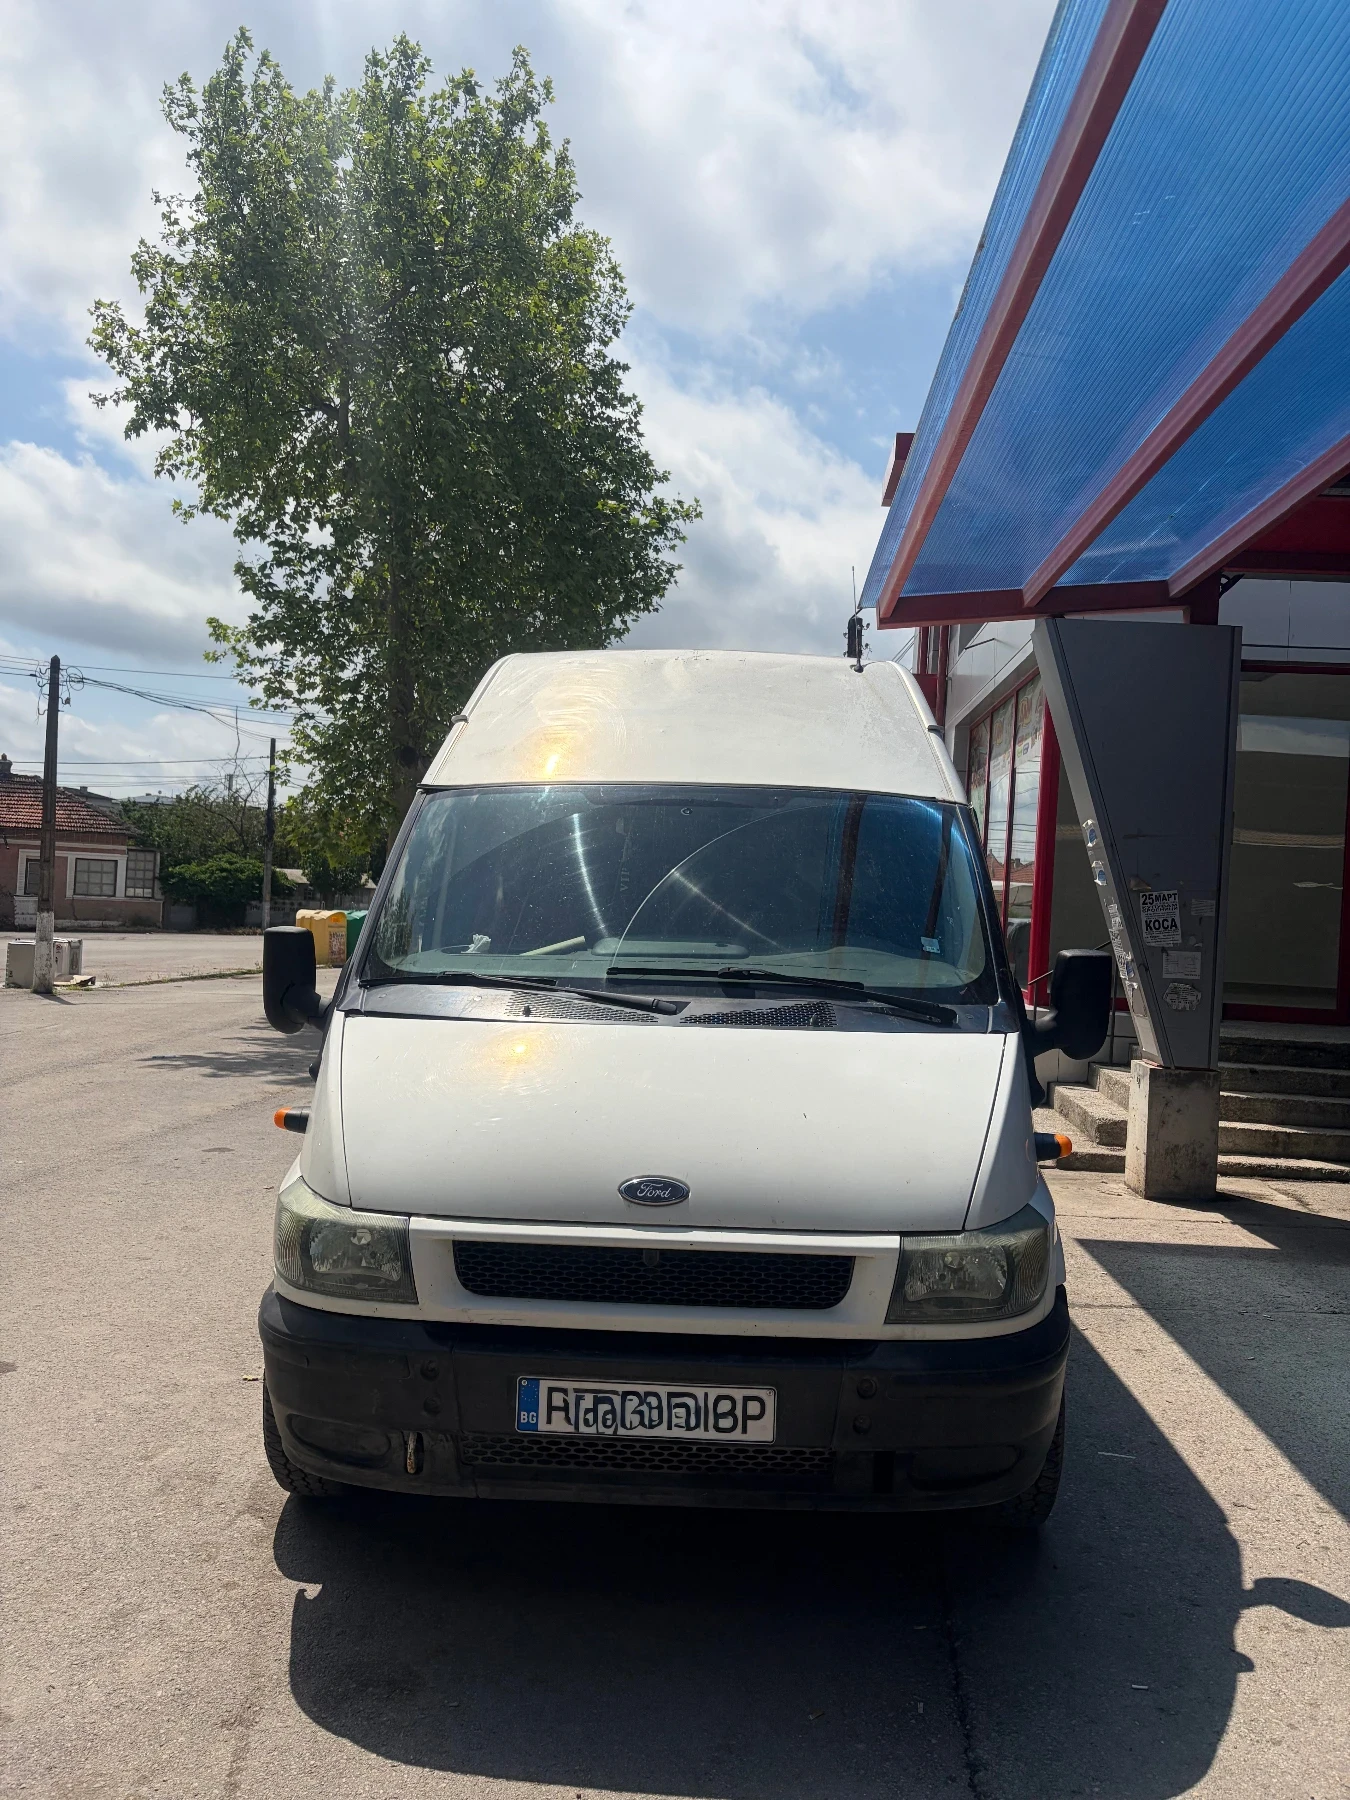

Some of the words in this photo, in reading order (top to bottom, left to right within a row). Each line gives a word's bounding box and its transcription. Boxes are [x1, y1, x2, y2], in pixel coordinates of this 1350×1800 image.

[1141, 893, 1155, 905] 25
[1154, 893, 1178, 903] МАРТ
[1145, 918, 1178, 931] КОСА
[636, 1182, 672, 1198] Ford
[520, 1411, 537, 1424] BG
